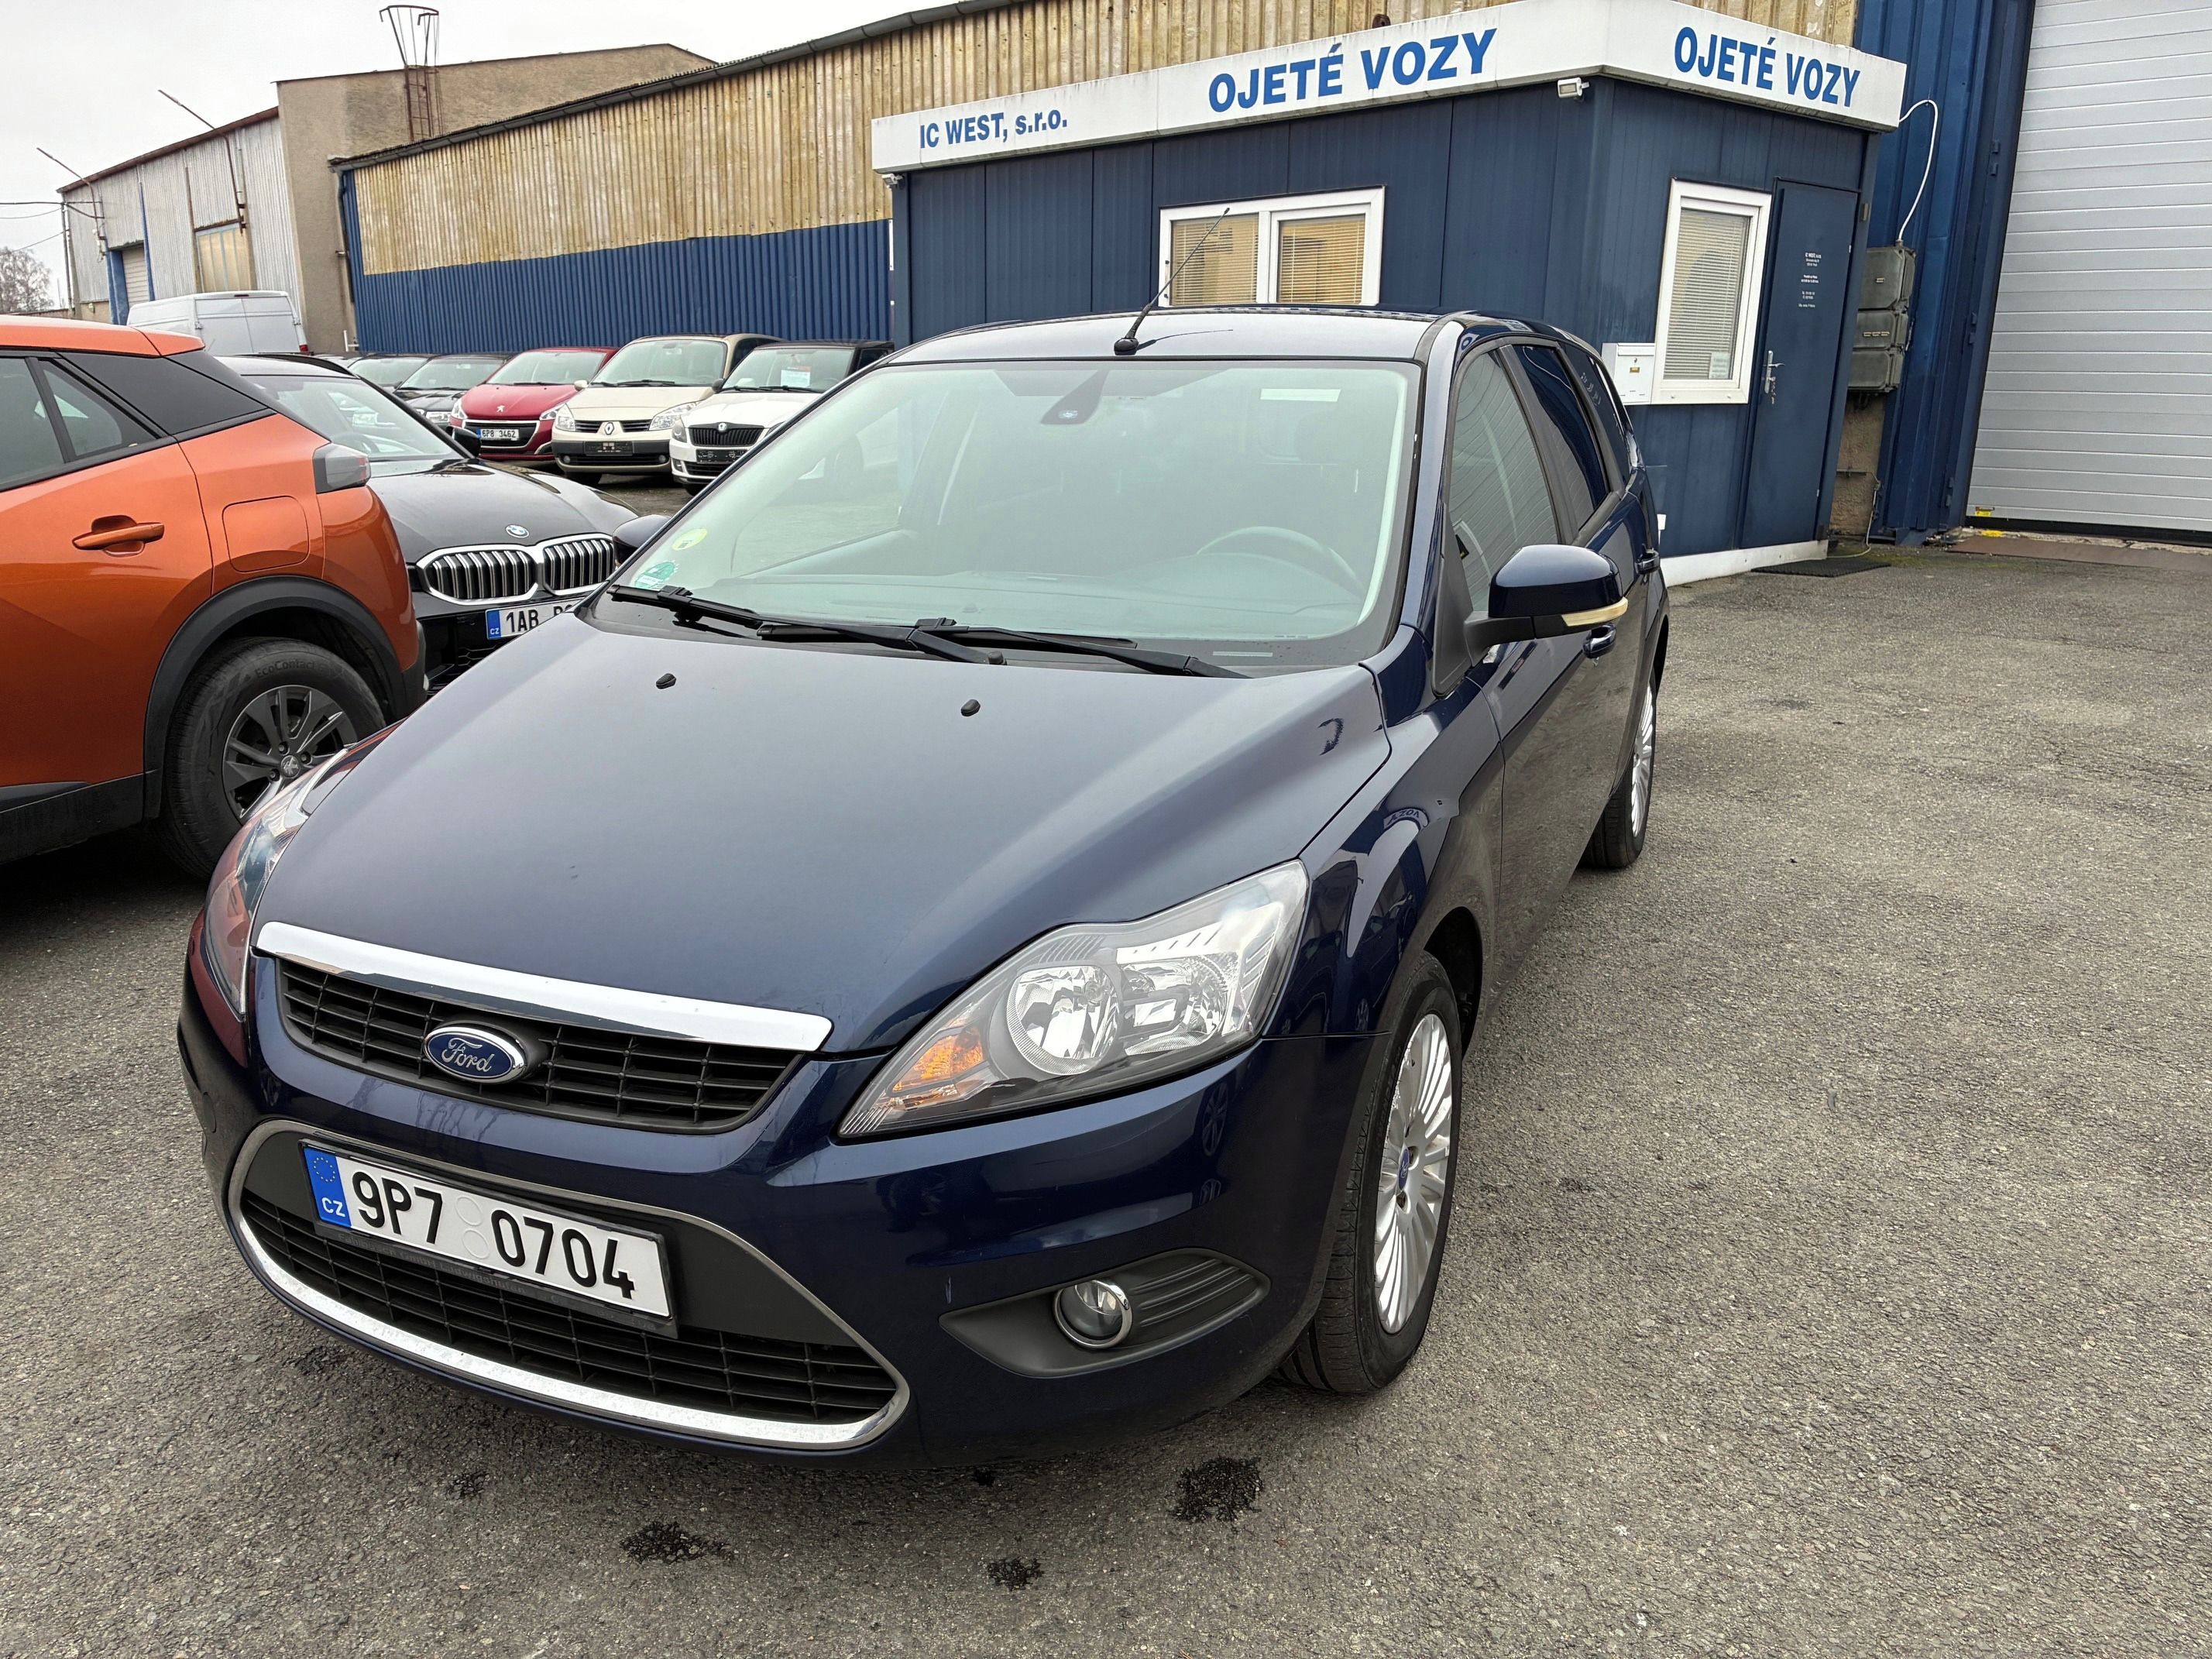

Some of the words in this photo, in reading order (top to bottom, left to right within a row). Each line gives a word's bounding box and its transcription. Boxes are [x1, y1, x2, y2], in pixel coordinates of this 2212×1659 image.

[1209, 43, 1344, 113] OJETÉ
[1360, 28, 1497, 90] VOZY
[1674, 26, 1776, 91] OJETÉ
[1786, 53, 1860, 108] VOZY
[919, 123, 939, 149] IC
[945, 112, 1008, 146] WEST,
[1015, 109, 1067, 136] s.r.o.
[499, 430, 517, 438] 3462
[506, 609, 539, 633] 1AB
[441, 1037, 495, 1073] Ford
[321, 1197, 346, 1218] CZ
[352, 1171, 443, 1245] 9P7
[490, 1209, 635, 1300] 0704
